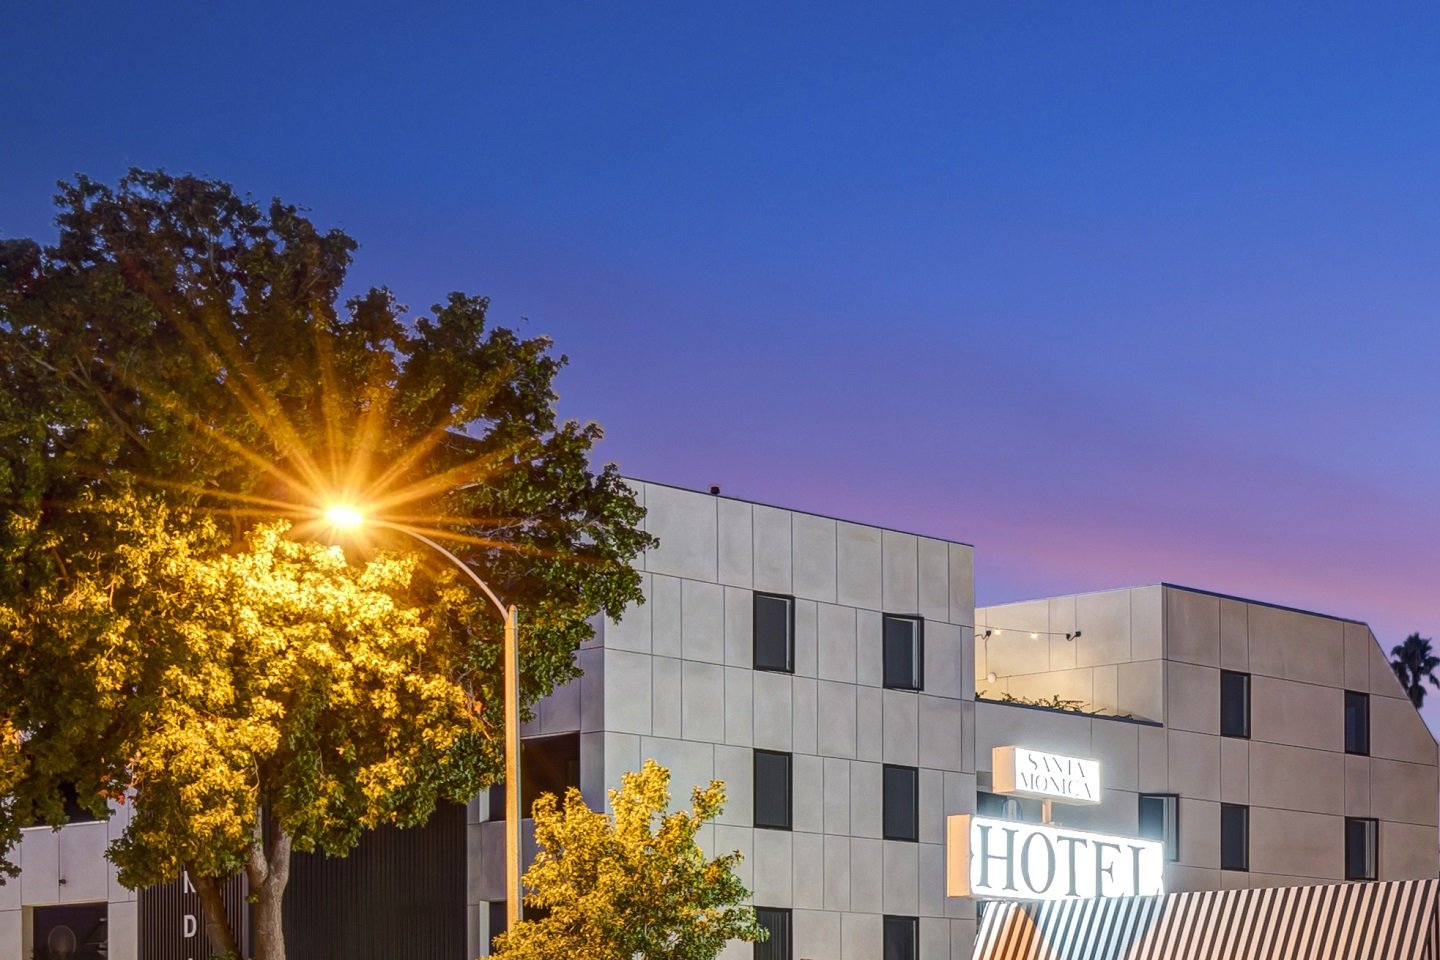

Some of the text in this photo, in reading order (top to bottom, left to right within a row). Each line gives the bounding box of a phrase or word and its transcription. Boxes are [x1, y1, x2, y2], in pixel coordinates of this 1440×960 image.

[1027, 753, 1086, 778] SANTA
[1020, 771, 1092, 799] MONICA
[976, 824, 1160, 898] HOTEL
